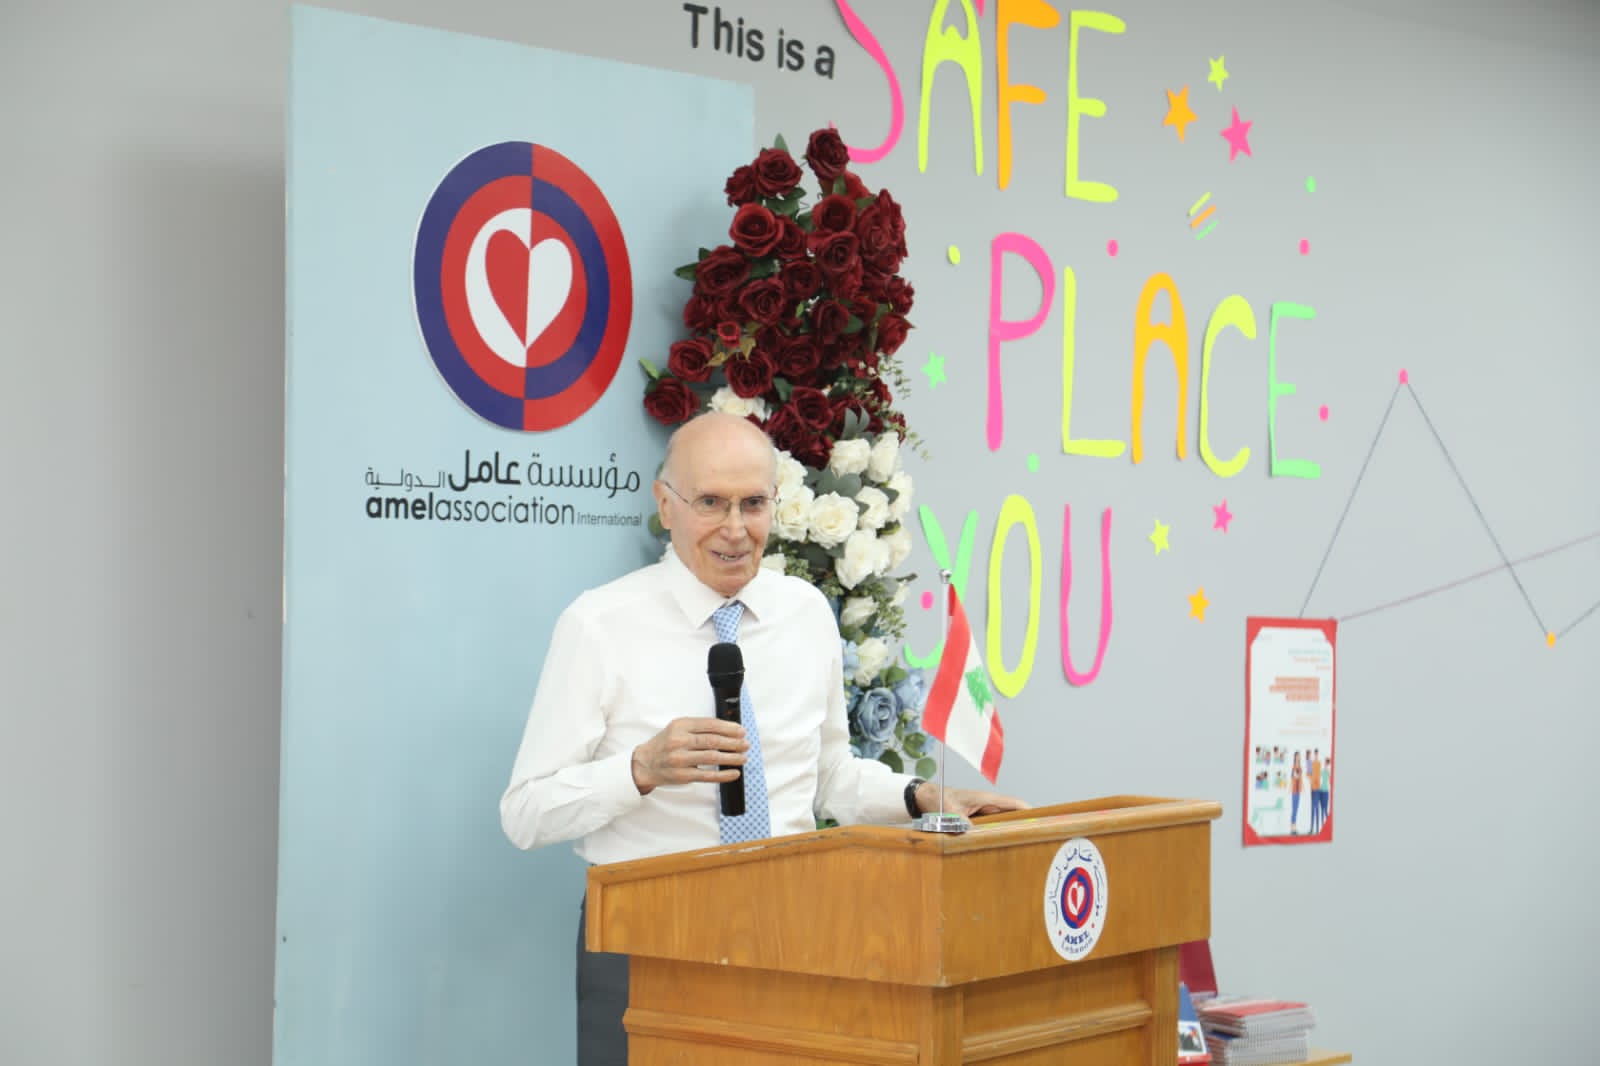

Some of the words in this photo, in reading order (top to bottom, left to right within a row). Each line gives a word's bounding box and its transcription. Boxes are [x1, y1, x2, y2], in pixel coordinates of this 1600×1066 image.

[683, 3, 764, 62] This
[777, 29, 804, 72] is
[815, 45, 836, 79] a
[986, 232, 1321, 479] PLACE
[365, 467, 445, 492] الدولية
[450, 450, 521, 492] عامل
[528, 453, 641, 499] مؤسسة
[904, 494, 1113, 698] YOU
[1064, 930, 1090, 945] AMEL
